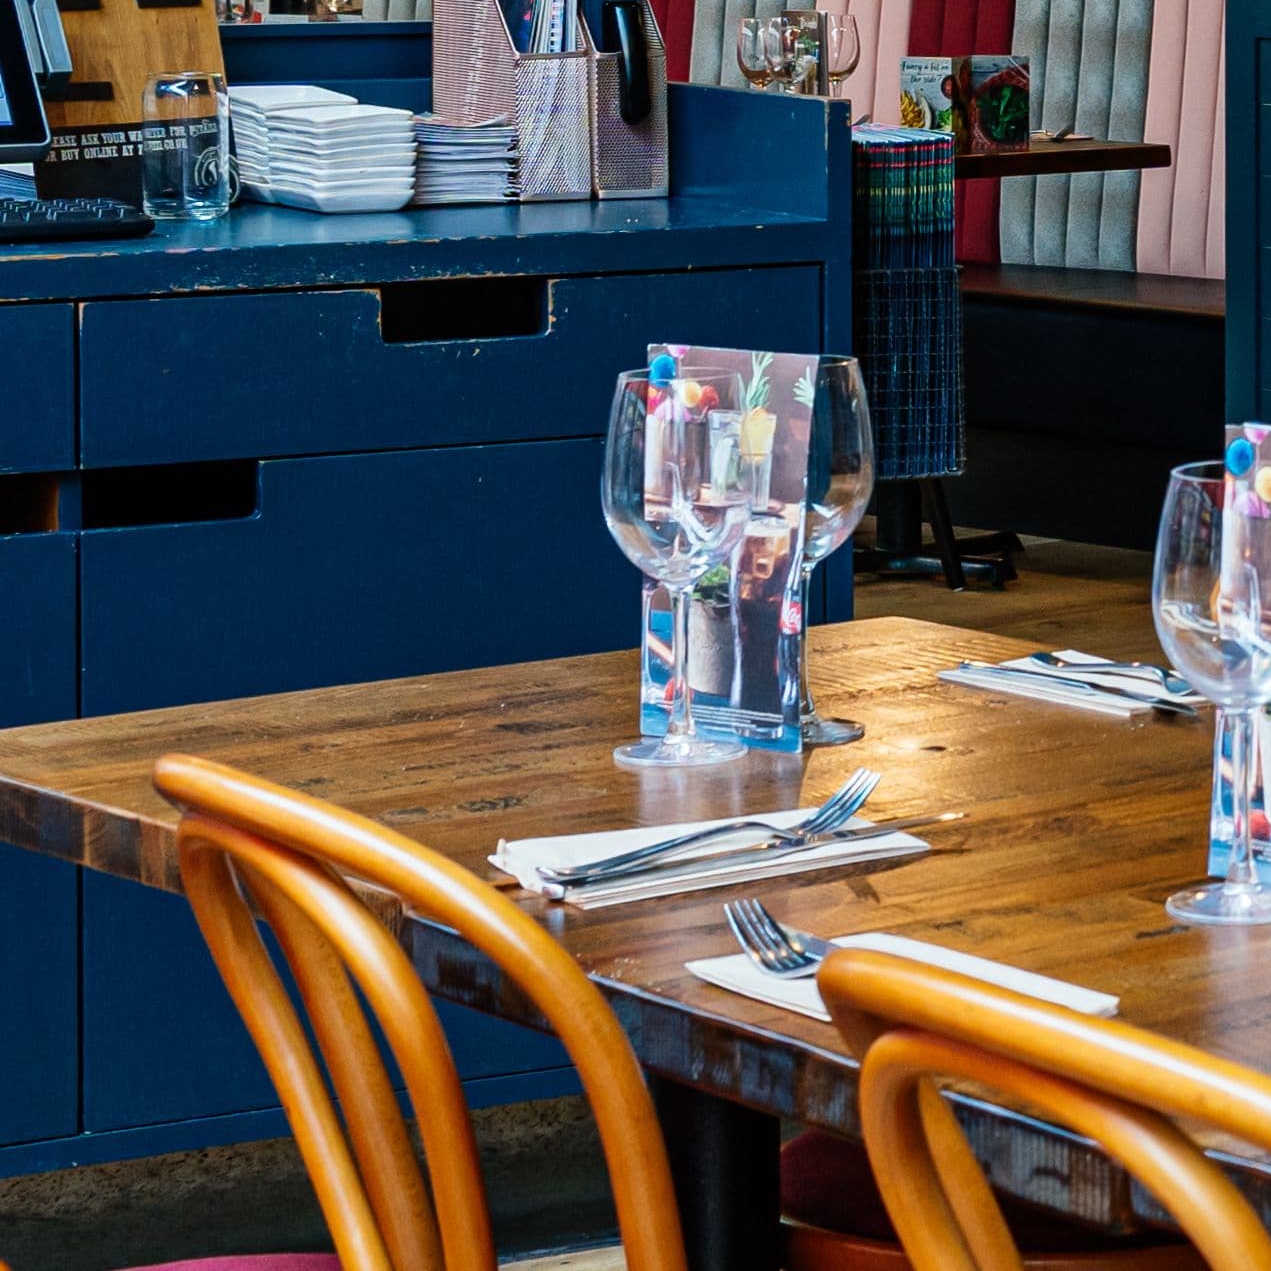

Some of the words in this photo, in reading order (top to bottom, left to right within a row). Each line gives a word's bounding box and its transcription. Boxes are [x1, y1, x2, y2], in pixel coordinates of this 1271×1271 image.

[81, 133, 100, 146] ASK
[100, 131, 126, 144] YOUR
[61, 148, 80, 161] BUY
[84, 146, 119, 159] ONLINE
[122, 144, 134, 157] AT
